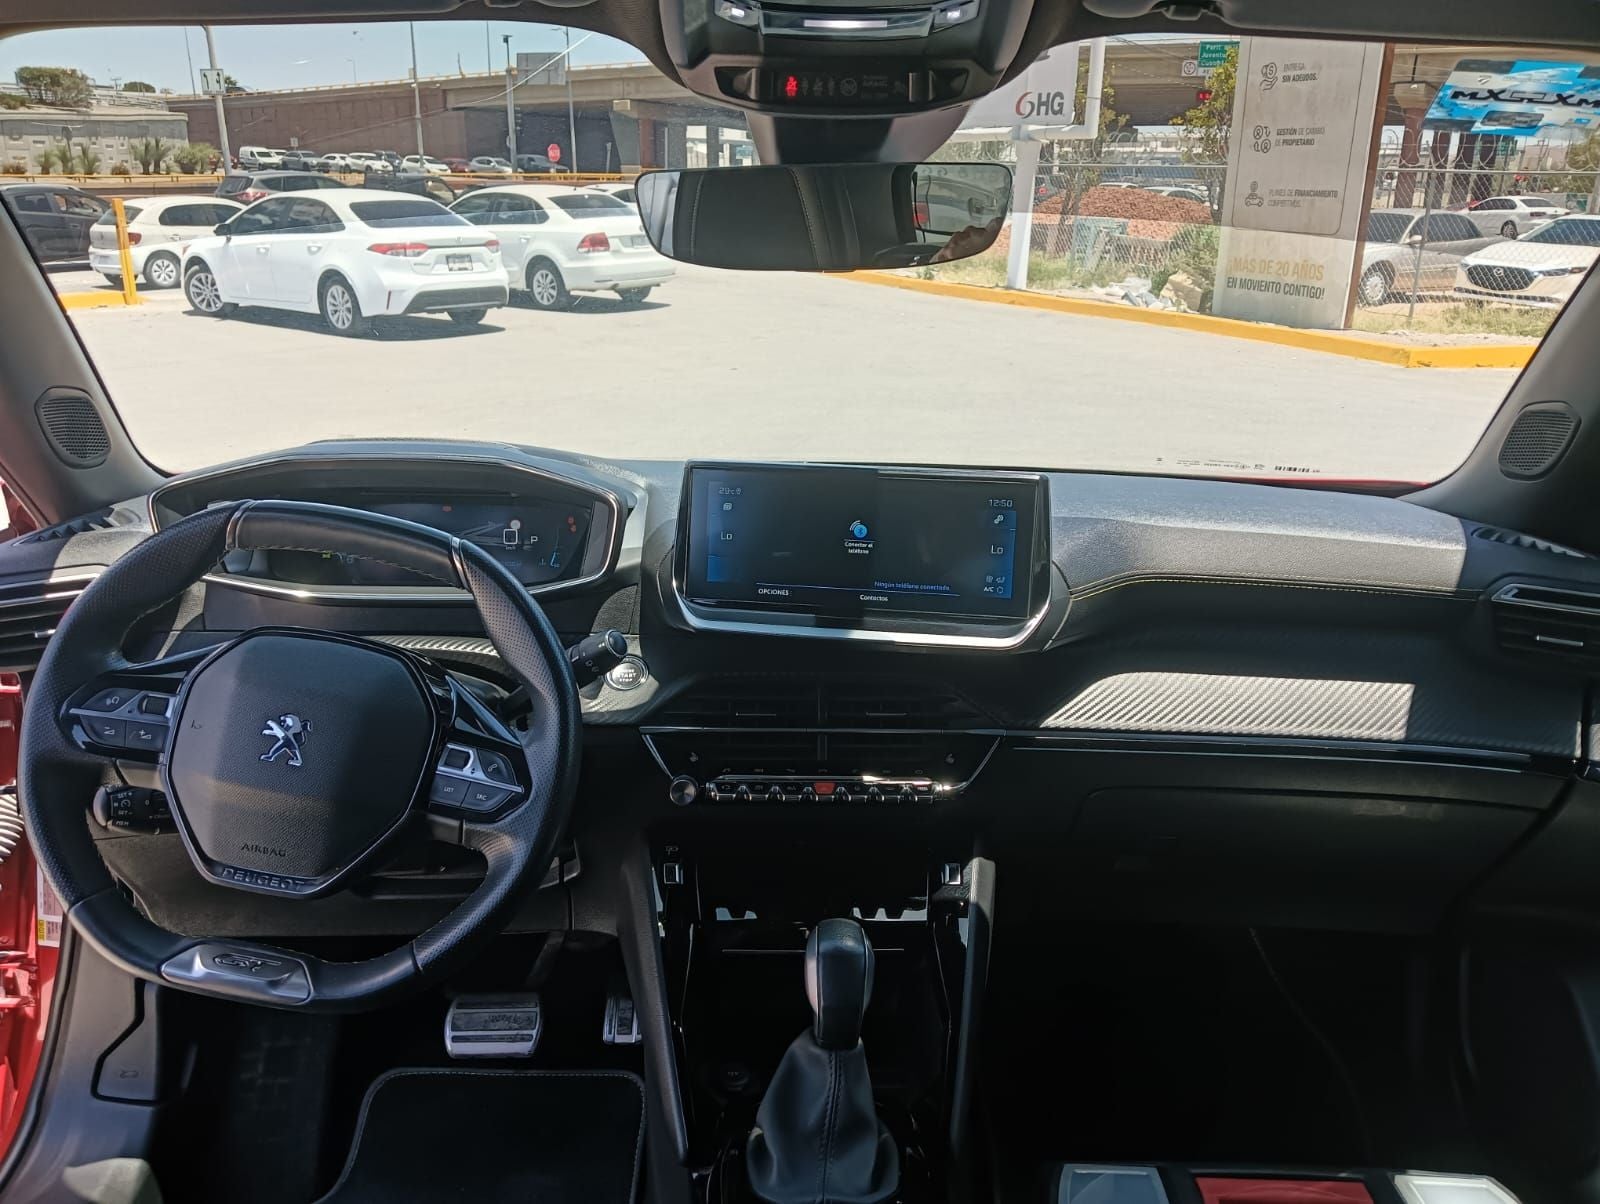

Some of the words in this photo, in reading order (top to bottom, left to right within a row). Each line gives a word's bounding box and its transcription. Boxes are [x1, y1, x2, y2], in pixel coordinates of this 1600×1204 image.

[1282, 138, 1315, 146] PROPIETARIO
[1294, 189, 1338, 198] FINANCIAMIENTO
[1259, 259, 1274, 275] DE
[1276, 261, 1291, 277] 20
[1292, 260, 1325, 281] AÑOS
[1226, 276, 1238, 289] EN
[1238, 278, 1281, 294] MOVIENTO
[1283, 282, 1325, 300] CONTIGO!
[989, 499, 1013, 508] 12:50
[530, 535, 539, 545] P
[720, 531, 733, 541] Lo
[991, 544, 1004, 555] Lo
[758, 588, 789, 596] OPCIONES
[859, 594, 889, 602] Contactos
[241, 843, 287, 858] AIRBAG
[222, 867, 305, 891] PEUGEOT
